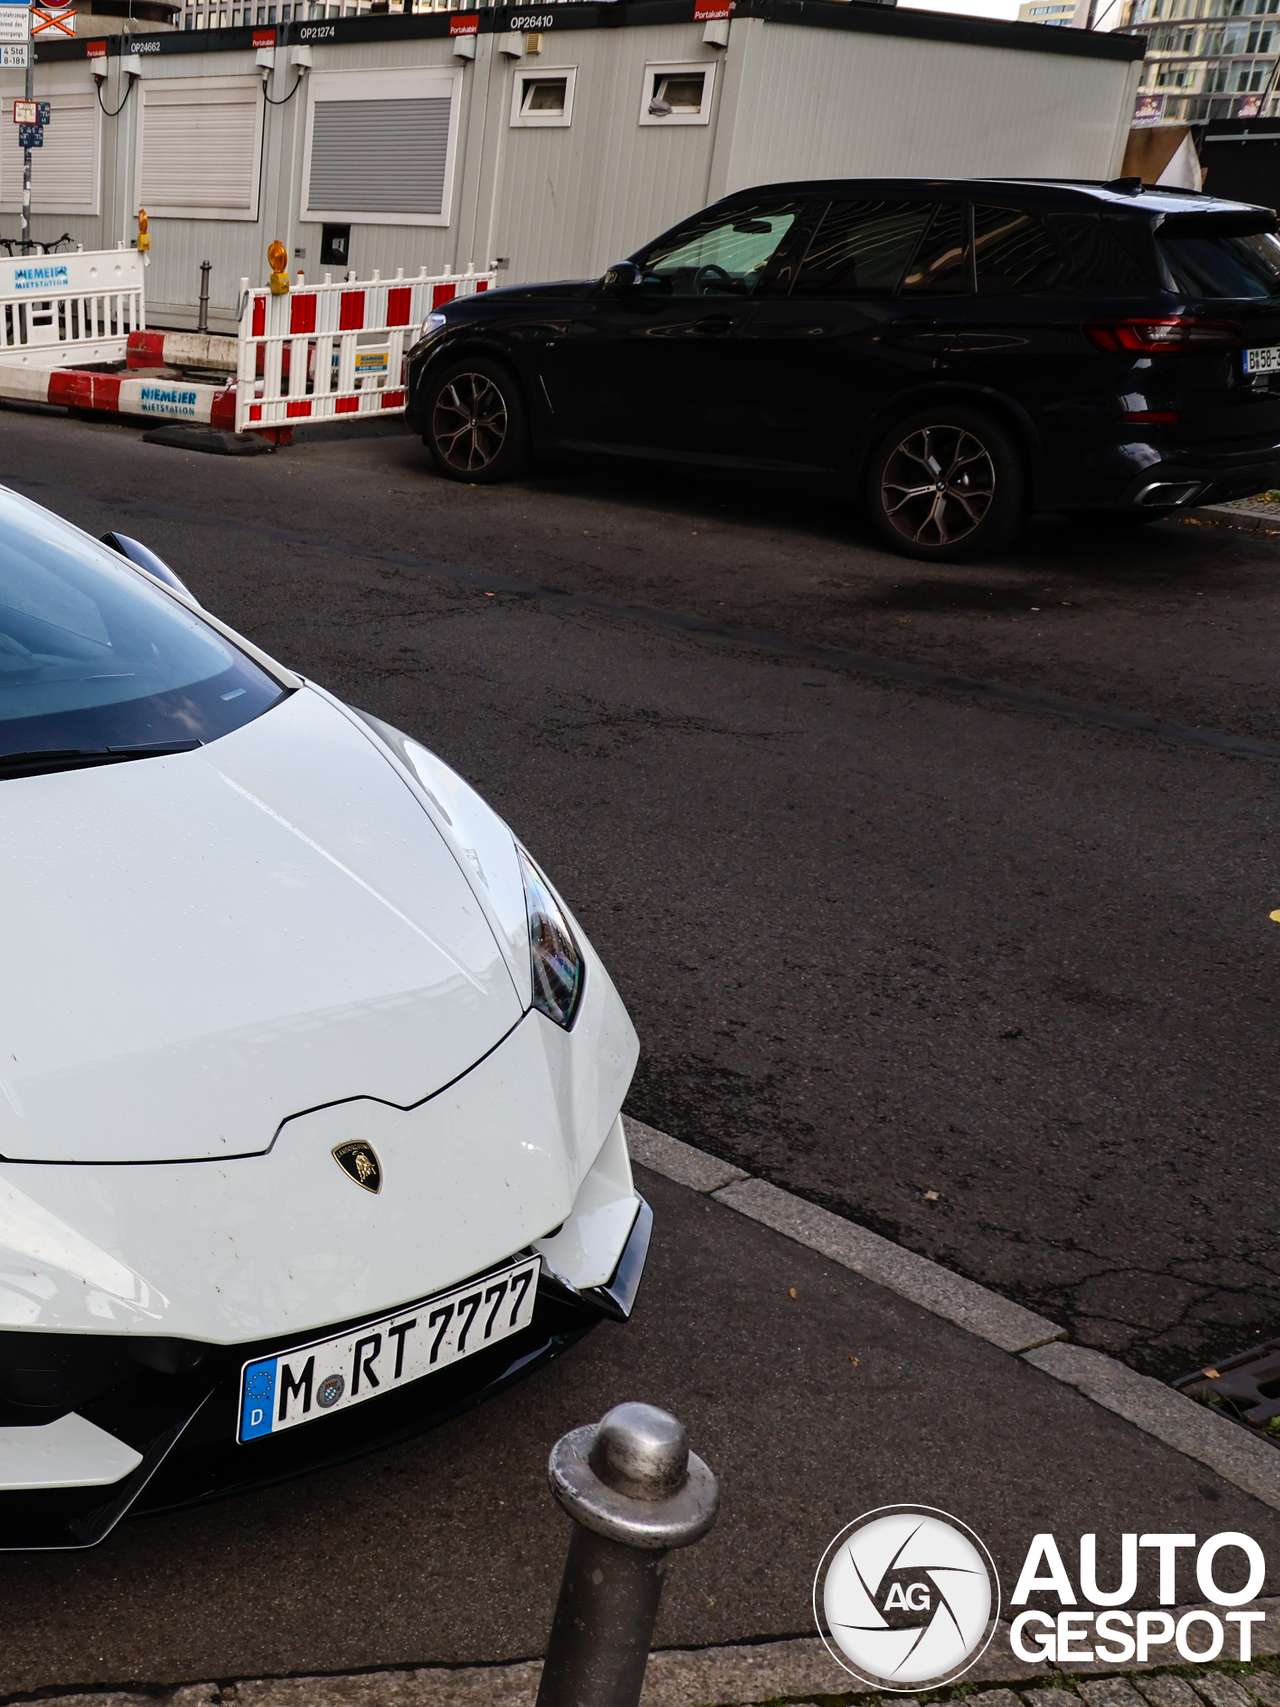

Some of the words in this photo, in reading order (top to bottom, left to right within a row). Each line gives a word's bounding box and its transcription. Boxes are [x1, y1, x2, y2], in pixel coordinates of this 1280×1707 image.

[694, 9, 729, 19] Portakabin
[510, 15, 553, 29] OP26410
[300, 26, 335, 39] OP21274
[450, 25, 477, 34] Portakabin
[131, 41, 161, 53] OP24662
[252, 39, 275, 47] Portakabin
[3, 47, 9, 55] 4
[14, 265, 68, 280] NIEMEIER
[15, 279, 68, 290] MIETSTATION
[141, 387, 197, 405] NIEMEIER
[141, 402, 195, 416] MIETSTATION
[278, 1355, 315, 1422] M
[351, 1318, 417, 1397] RT
[429, 1268, 534, 1365] 7777
[251, 1408, 264, 1427] D
